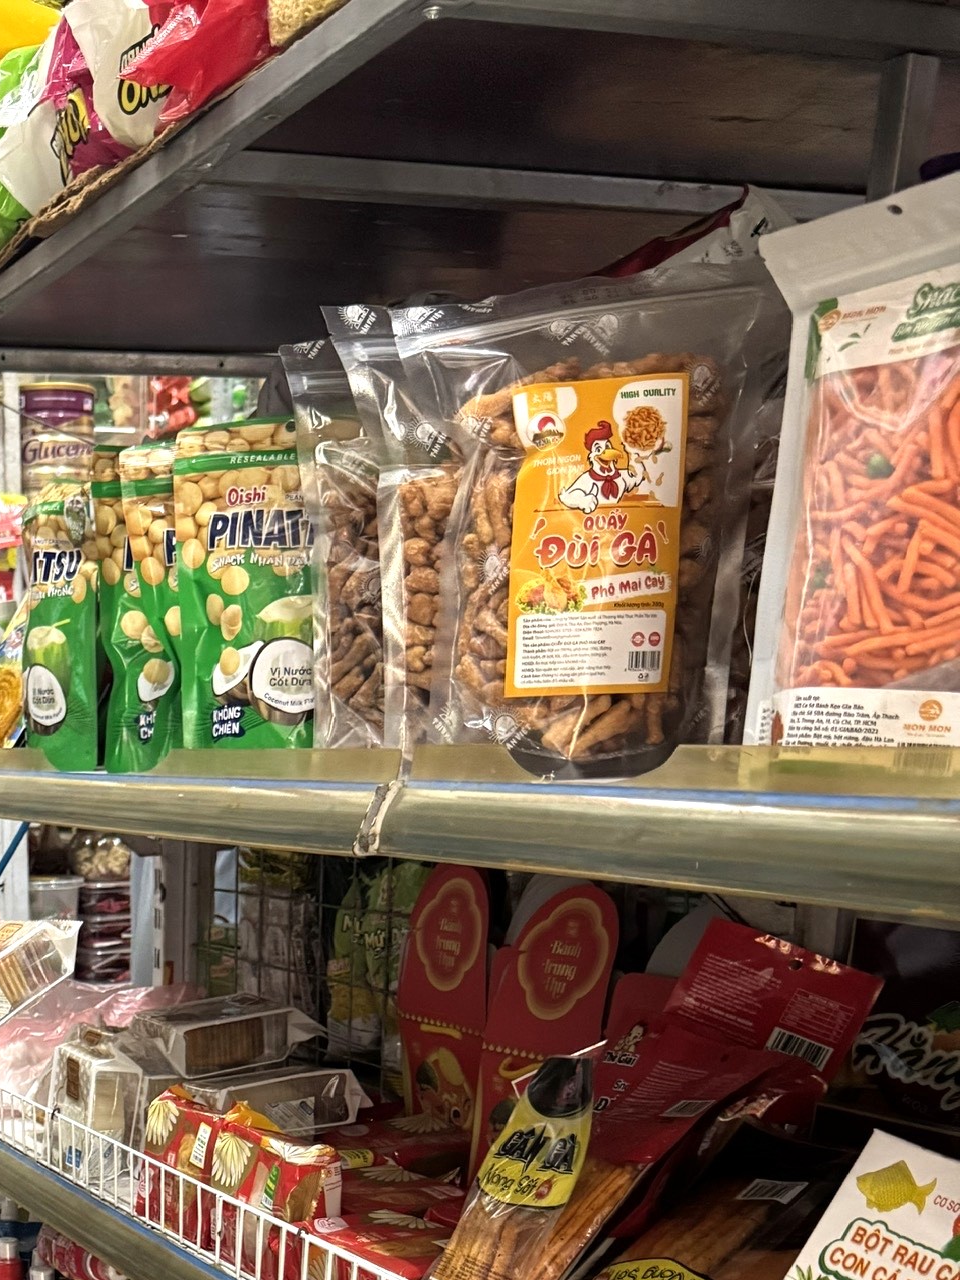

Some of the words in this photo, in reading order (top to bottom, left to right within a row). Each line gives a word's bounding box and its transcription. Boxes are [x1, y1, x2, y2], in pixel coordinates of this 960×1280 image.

[620, 391, 640, 400] HIGH
[229, 452, 297, 465] RESEALABLE
[226, 486, 268, 508] Oishi
[534, 533, 601, 568] ĐÙI
[610, 523, 658, 566] GÀ
[211, 554, 246, 573] SNACK
[591, 582, 616, 600] Phô
[619, 578, 641, 595] Mai
[644, 574, 666, 591] Cay
[270, 667, 281, 678] Vị
[269, 677, 289, 688] Cốt
[212, 704, 242, 723] KHÔNG
[903, 723, 926, 733] MON
[929, 724, 952, 734] MON
[850, 1225, 894, 1256] BỘT
[892, 1244, 936, 1276] RAU
[829, 1246, 872, 1279] CON
